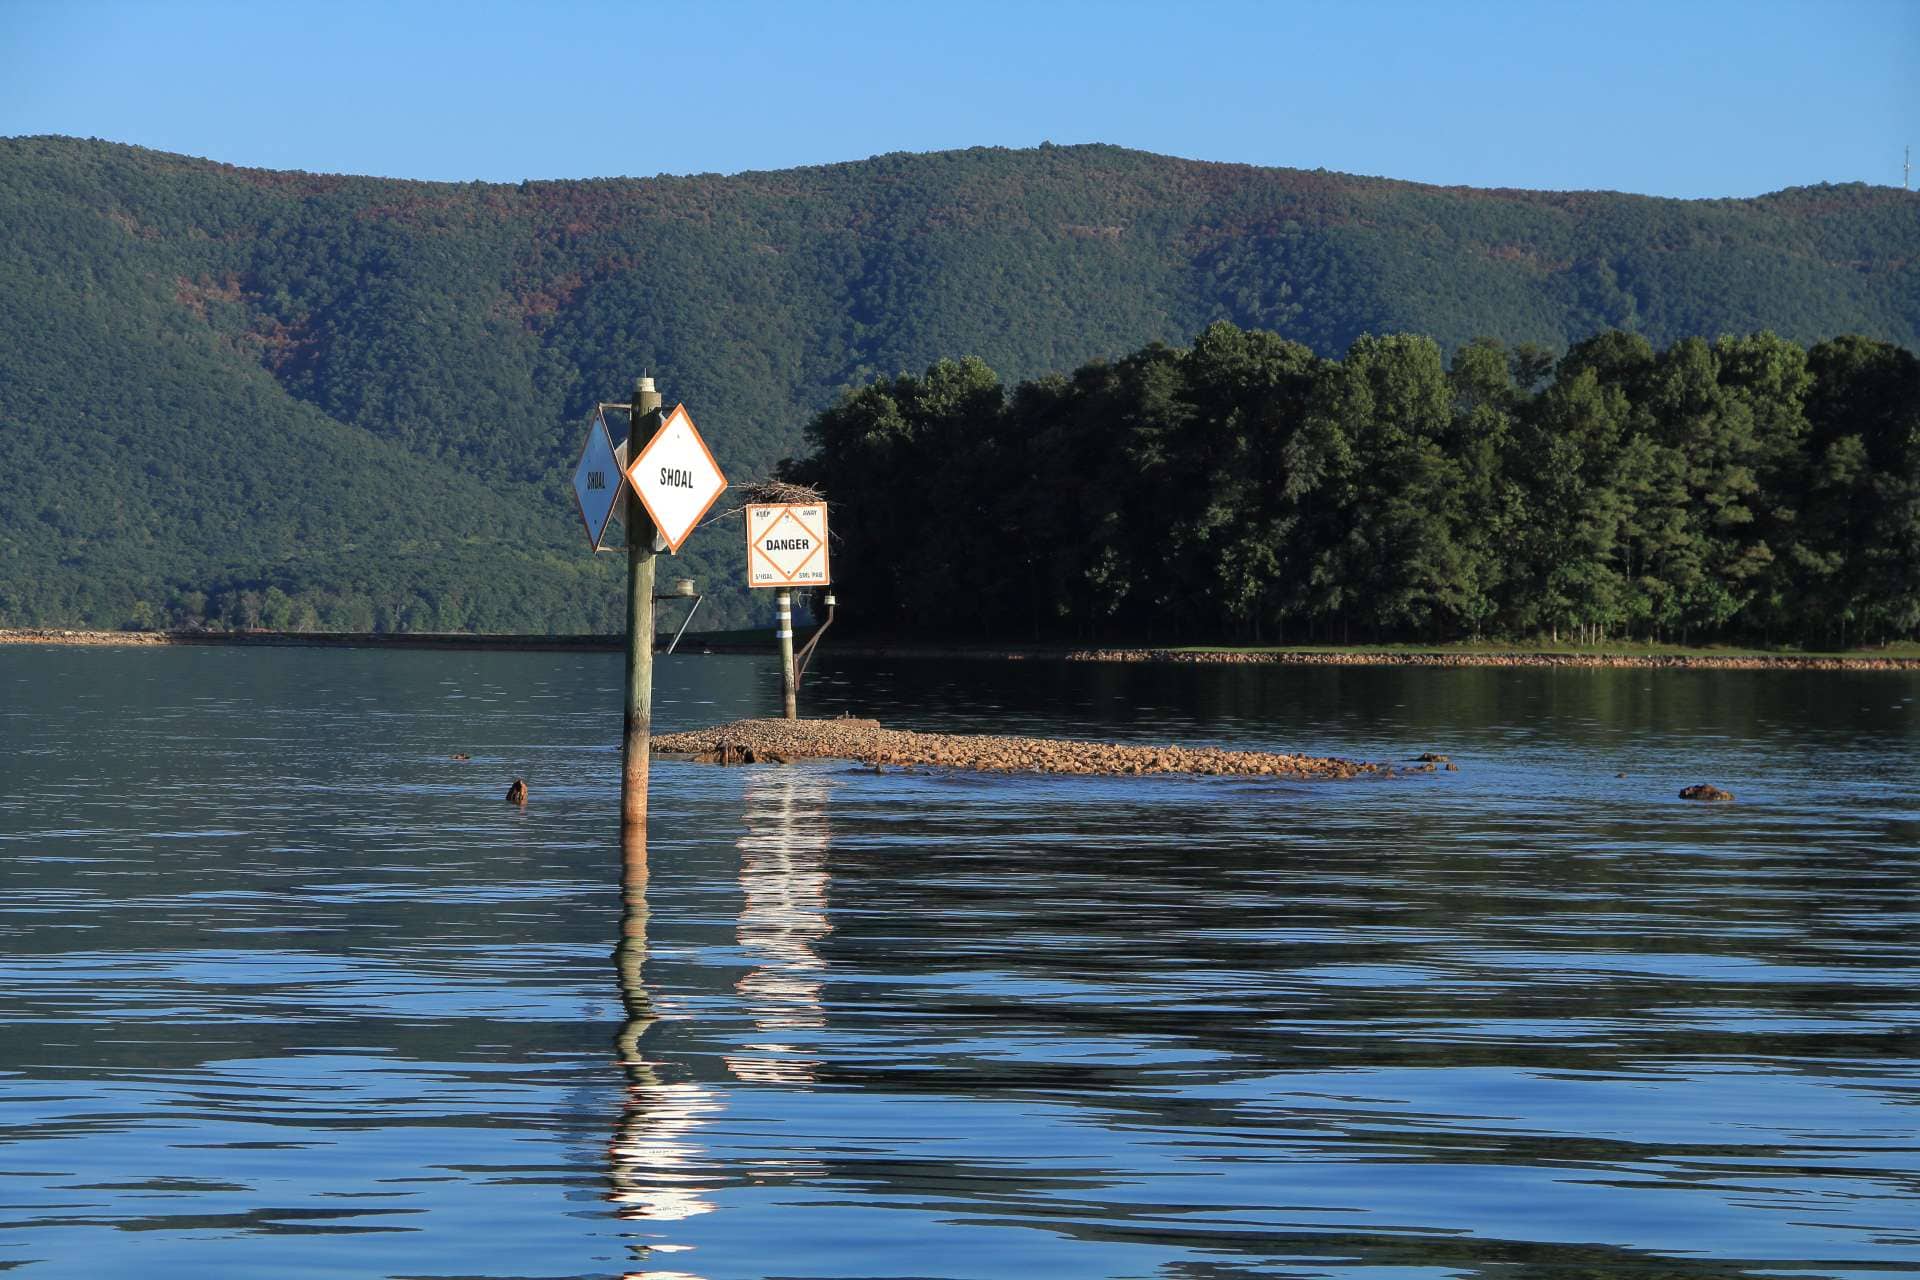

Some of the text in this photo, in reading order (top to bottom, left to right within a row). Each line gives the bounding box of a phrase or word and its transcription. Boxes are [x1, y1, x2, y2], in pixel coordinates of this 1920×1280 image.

[587, 471, 606, 490] SHOAL
[660, 467, 694, 489] SHOAL
[766, 539, 809, 551] DANGER
